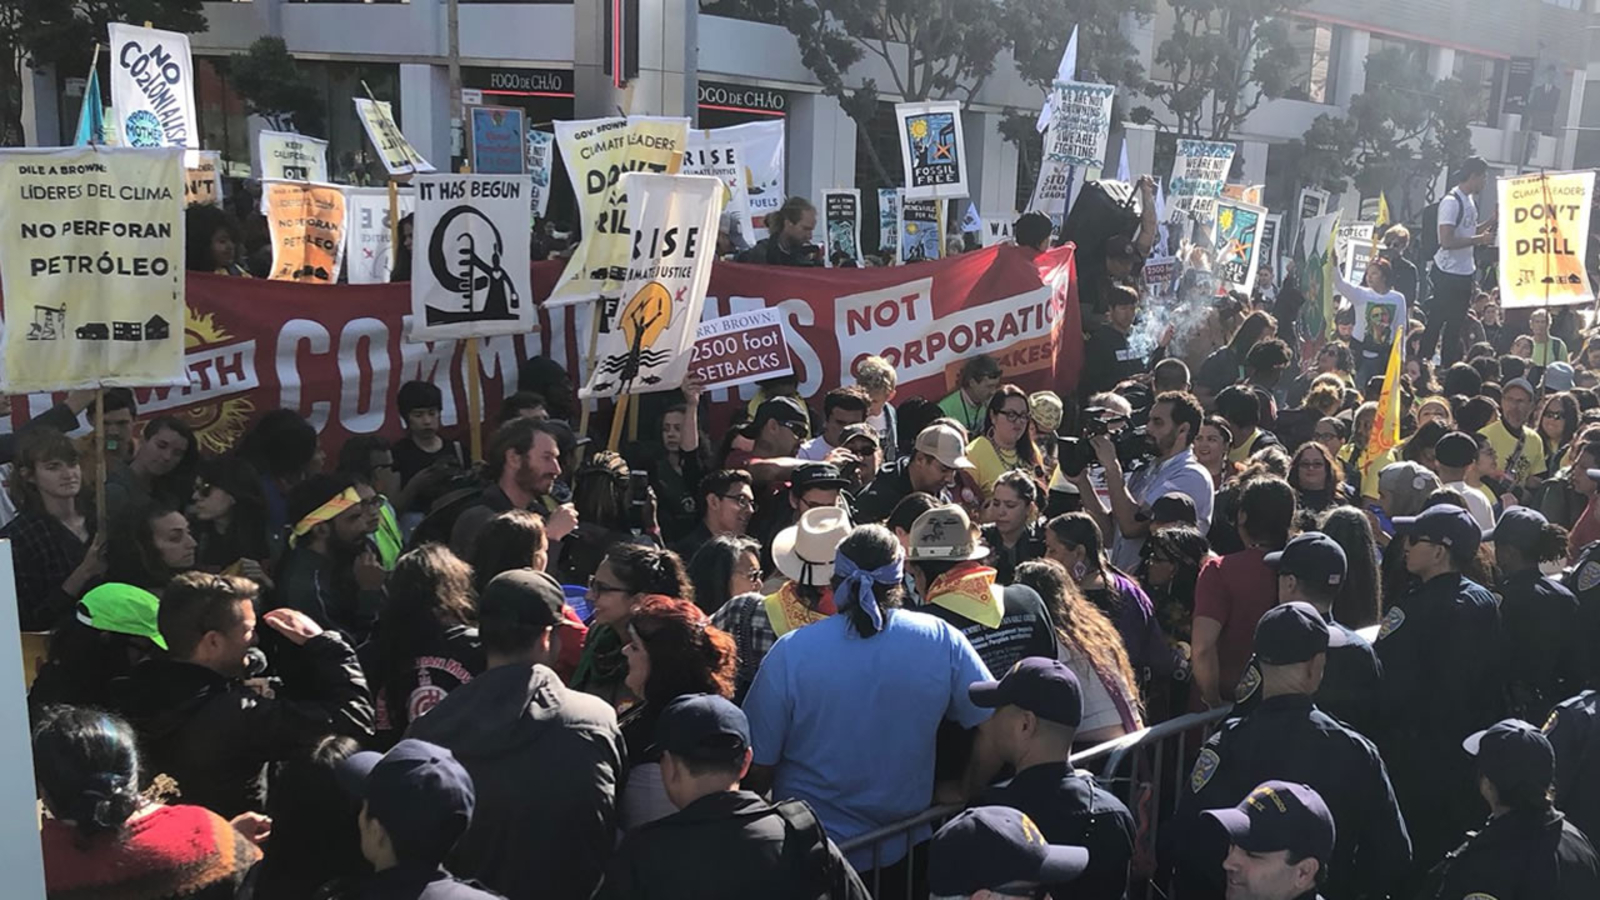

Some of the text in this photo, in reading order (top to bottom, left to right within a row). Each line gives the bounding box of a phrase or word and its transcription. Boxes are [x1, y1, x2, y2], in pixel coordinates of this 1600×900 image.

[149, 44, 180, 85] NO
[491, 73, 562, 90] FOGO DE CHÃO
[698, 86, 785, 110] OGO DE CHÃO
[574, 129, 596, 140] GOV.
[683, 148, 736, 166] RISE
[19, 165, 46, 175] DILE
[48, 165, 58, 175] A
[915, 165, 956, 177] FOSSIL
[917, 174, 955, 185] FREE
[20, 183, 173, 201] LÍDERES DEL CLIMA
[420, 180, 520, 200] IT HAS BEGUN
[750, 198, 778, 208] FUELS
[1514, 203, 1580, 223] DON'T
[21, 219, 171, 239] NO PERFORAN
[278, 219, 293, 228] NO
[1339, 228, 1369, 237] ROTECT
[1515, 238, 1575, 256] DRILL
[30, 250, 169, 277] PETRÓLEO
[656, 266, 692, 279] JUSTICE
[722, 311, 776, 331] BROWN:
[846, 293, 921, 336] NOT
[691, 330, 779, 363] 2500 foot
[696, 352, 780, 381] SETBACKS
